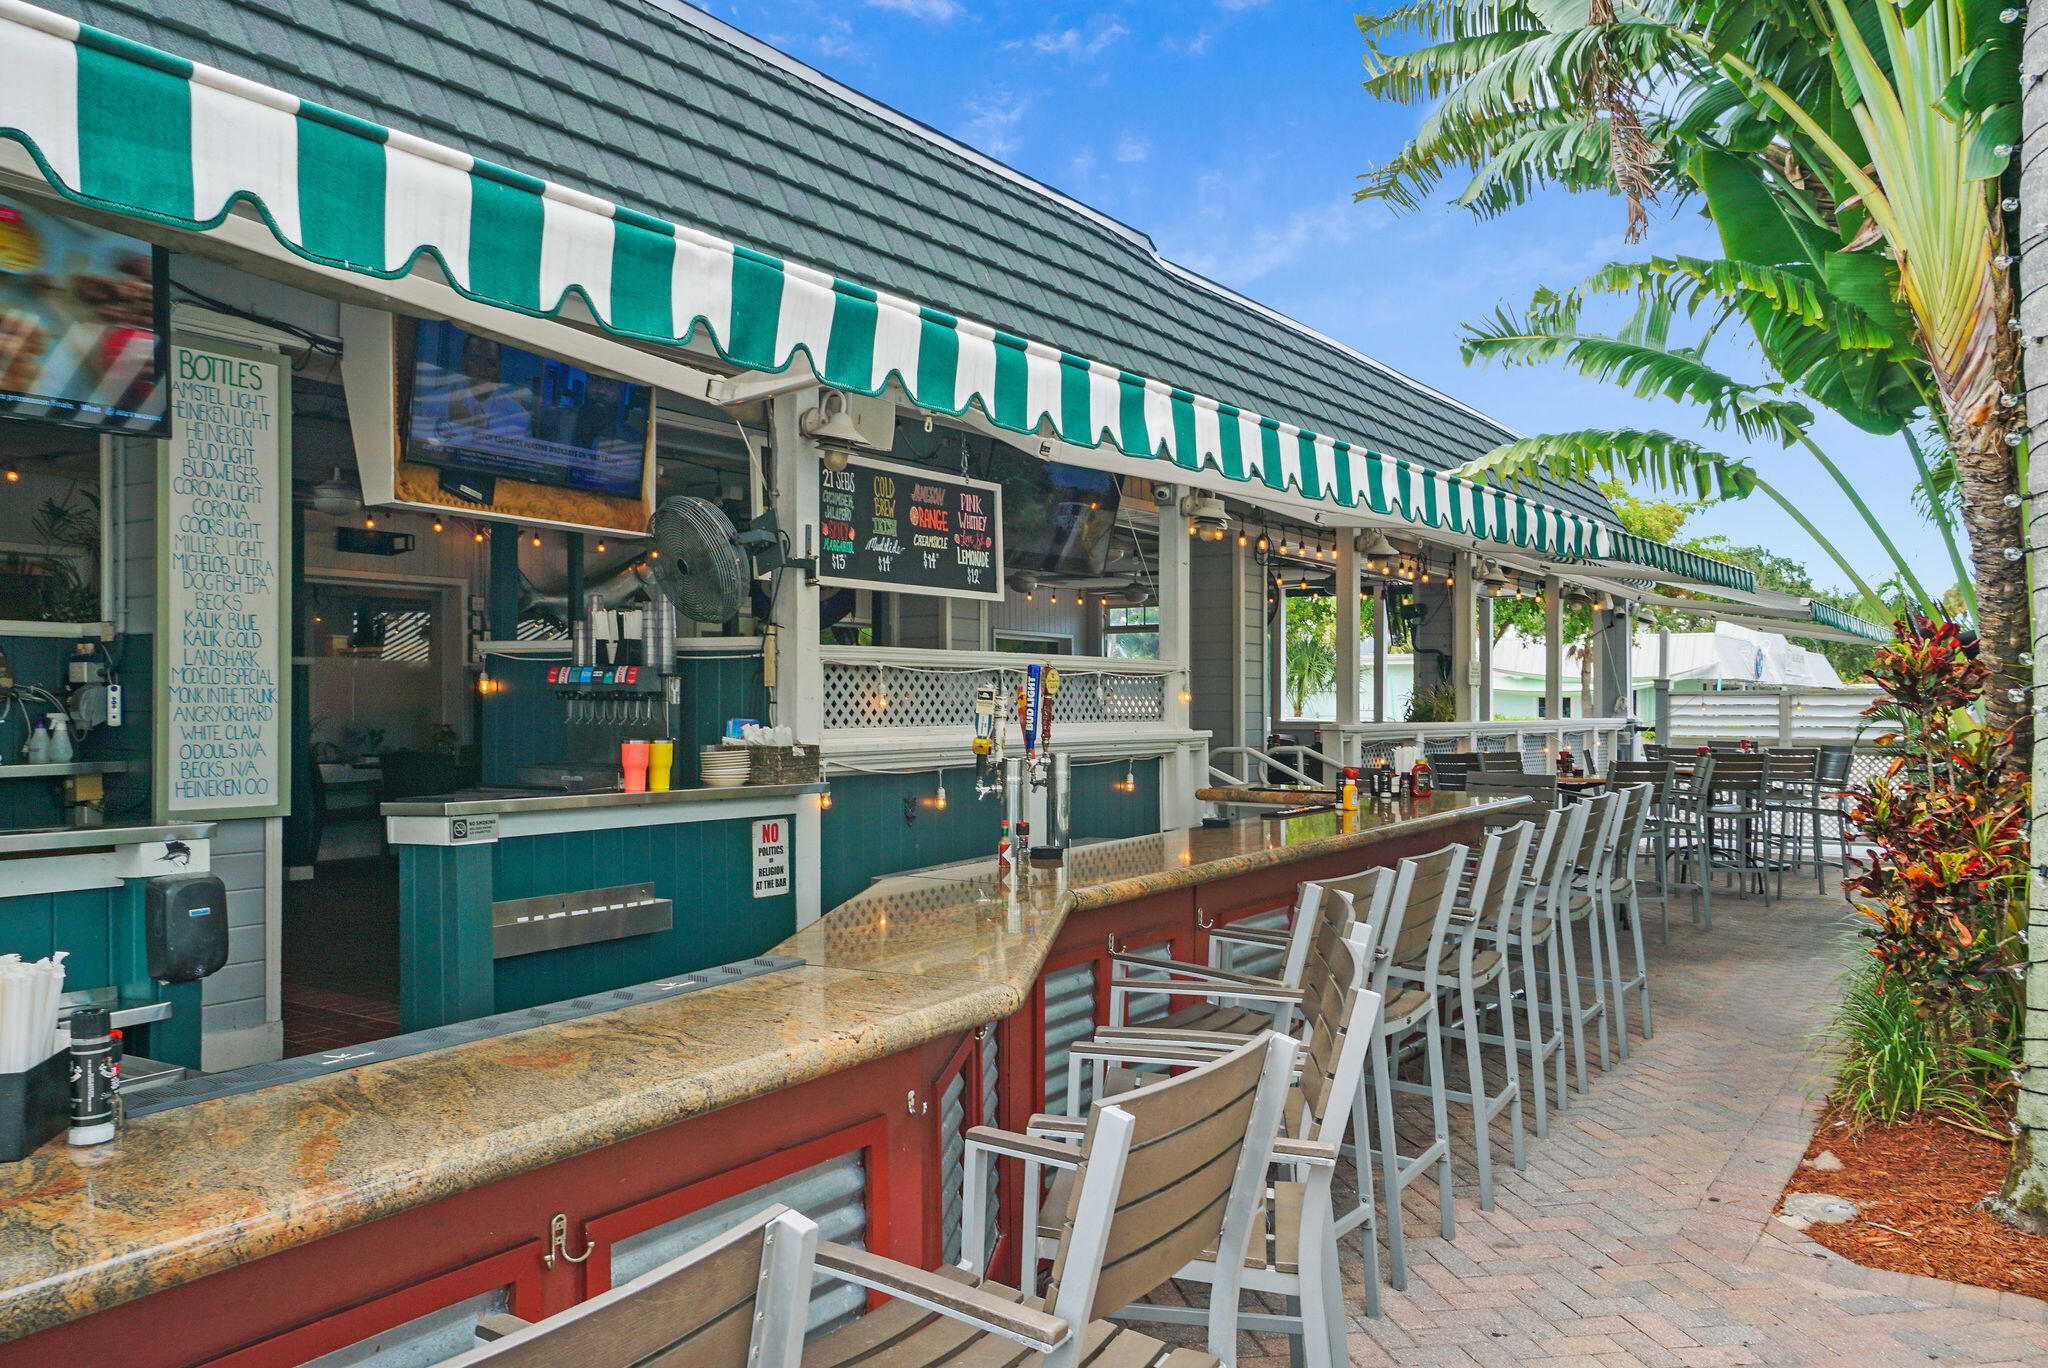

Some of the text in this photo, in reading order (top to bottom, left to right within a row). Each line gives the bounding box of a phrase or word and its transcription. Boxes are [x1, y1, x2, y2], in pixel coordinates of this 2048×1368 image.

[179, 349, 263, 391] BOTTLES
[172, 380, 269, 413] AMSTEL LIGHT
[233, 408, 272, 432] LIGHT
[185, 421, 254, 447] HEINEKEN
[187, 439, 256, 466] BUD LIGHT
[182, 458, 262, 486] BUDWEISER
[173, 477, 264, 504] CORONA LIGHT
[873, 476, 895, 499] COLD
[192, 498, 251, 520] CORONA
[874, 497, 896, 518] BREW
[959, 493, 983, 515] PINK
[180, 515, 262, 539] COORS LIGHT
[957, 511, 988, 532] WHITNEY
[174, 534, 264, 558] MILLER LIGHT
[172, 552, 274, 577] MICHELOB ULTRA
[956, 546, 990, 568] LEMONADE
[195, 592, 243, 611] BECKS
[184, 610, 260, 631] KALIK BLUE
[183, 629, 262, 648] KALIK GOLD
[183, 648, 261, 668] LANDSHARK
[171, 666, 274, 686] MODELO ESPECIAL
[169, 686, 204, 704] MONK
[240, 688, 278, 705] TRUNK
[1025, 676, 1036, 731] BUD LIGHT
[172, 705, 273, 723] ANGRY ORCHARD
[180, 725, 262, 740] WHITE CLAW
[180, 761, 226, 779] BECKS
[174, 779, 241, 798] HEINEKEN
[762, 823, 779, 844] NO
[758, 845, 784, 857] POLITICS
[758, 865, 785, 878] RELIGION
[755, 877, 787, 891] AT THE BAR
